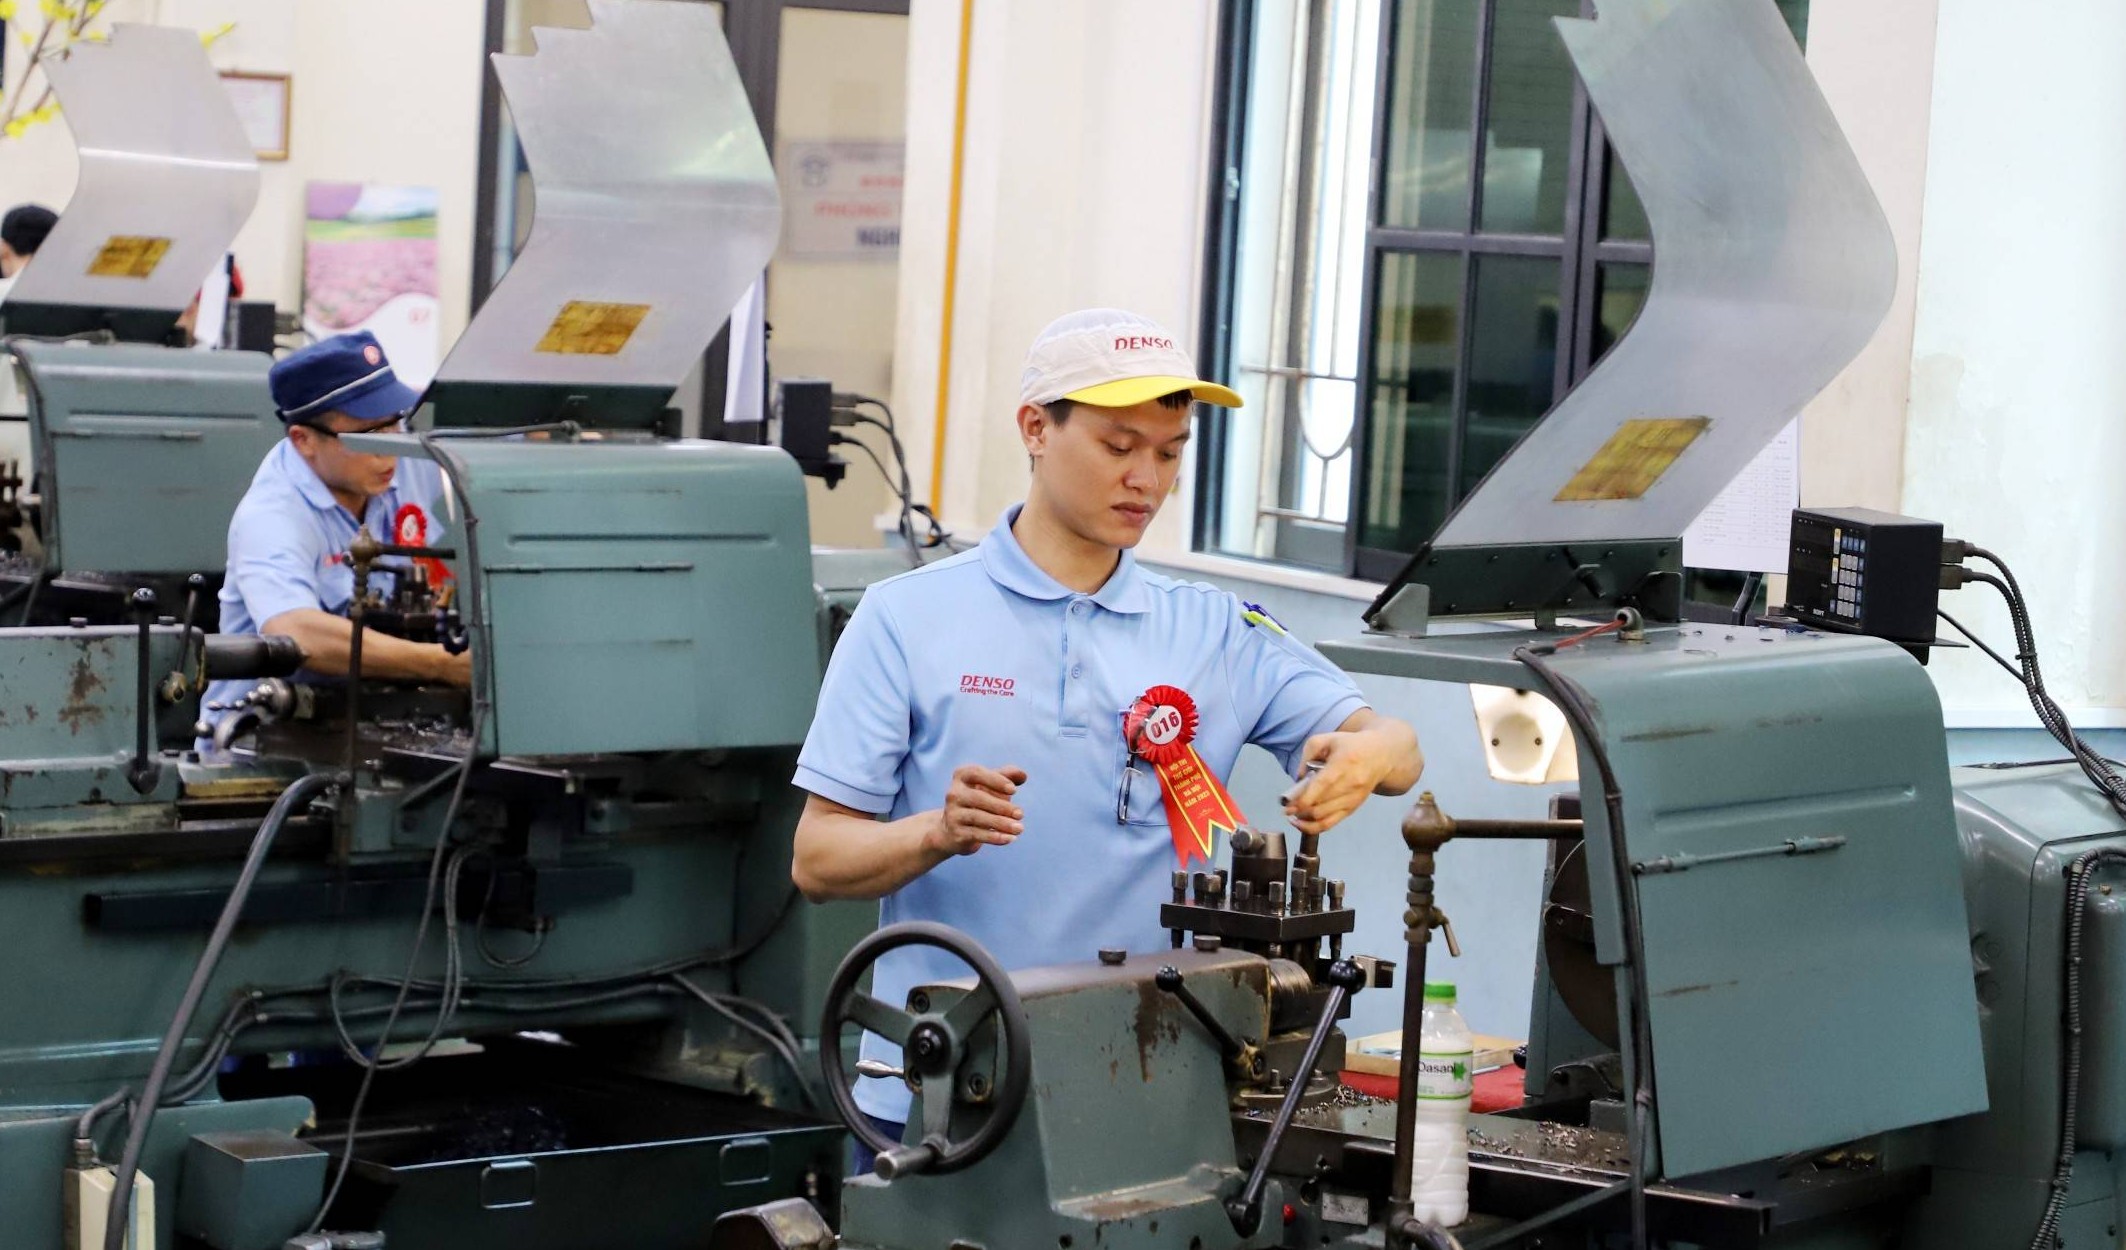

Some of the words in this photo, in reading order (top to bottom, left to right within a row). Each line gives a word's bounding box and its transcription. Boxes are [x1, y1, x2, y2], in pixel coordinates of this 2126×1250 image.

[1114, 336, 1174, 351] DENSO
[961, 675, 1014, 690] DENSO
[960, 686, 987, 696] Crafting
[1151, 711, 1179, 738] 016
